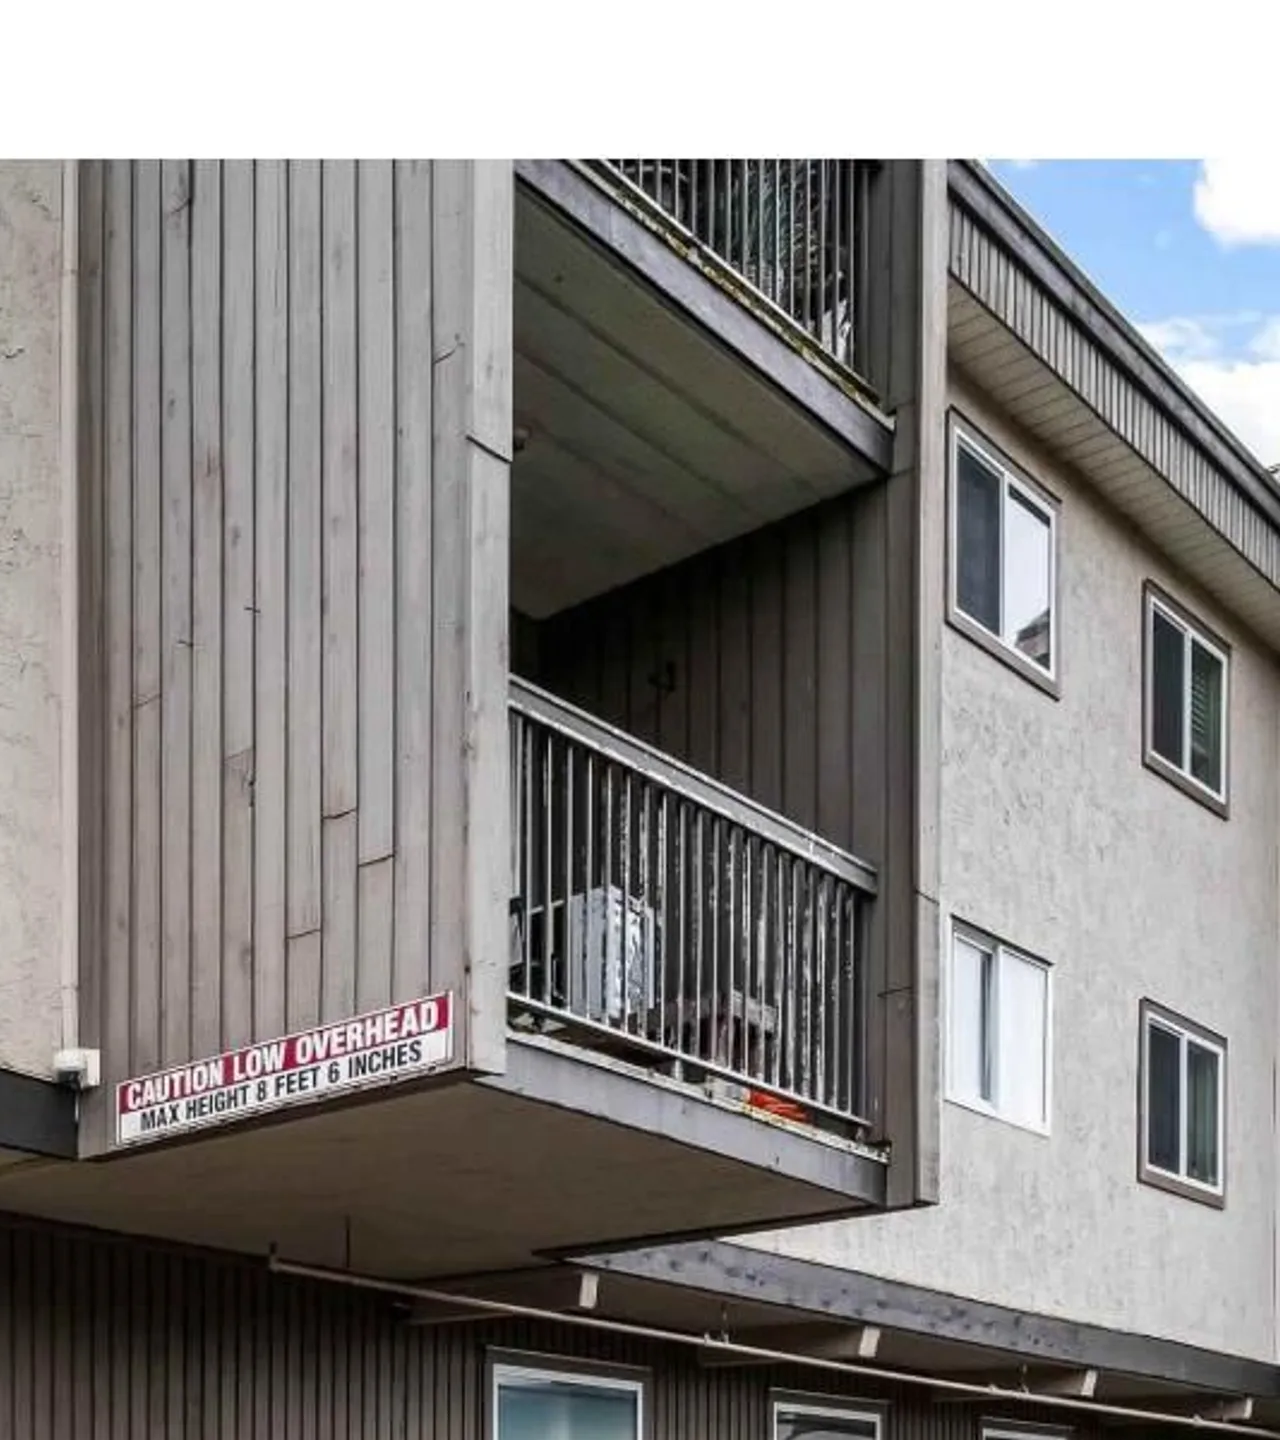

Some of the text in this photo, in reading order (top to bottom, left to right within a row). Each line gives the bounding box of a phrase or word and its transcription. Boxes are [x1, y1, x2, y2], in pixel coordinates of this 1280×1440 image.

[127, 1000, 439, 1110] CAUTION LOW OVERHEAD
[141, 1040, 422, 1131] MAX HEIGHT 8 FEET 6 INCHES
